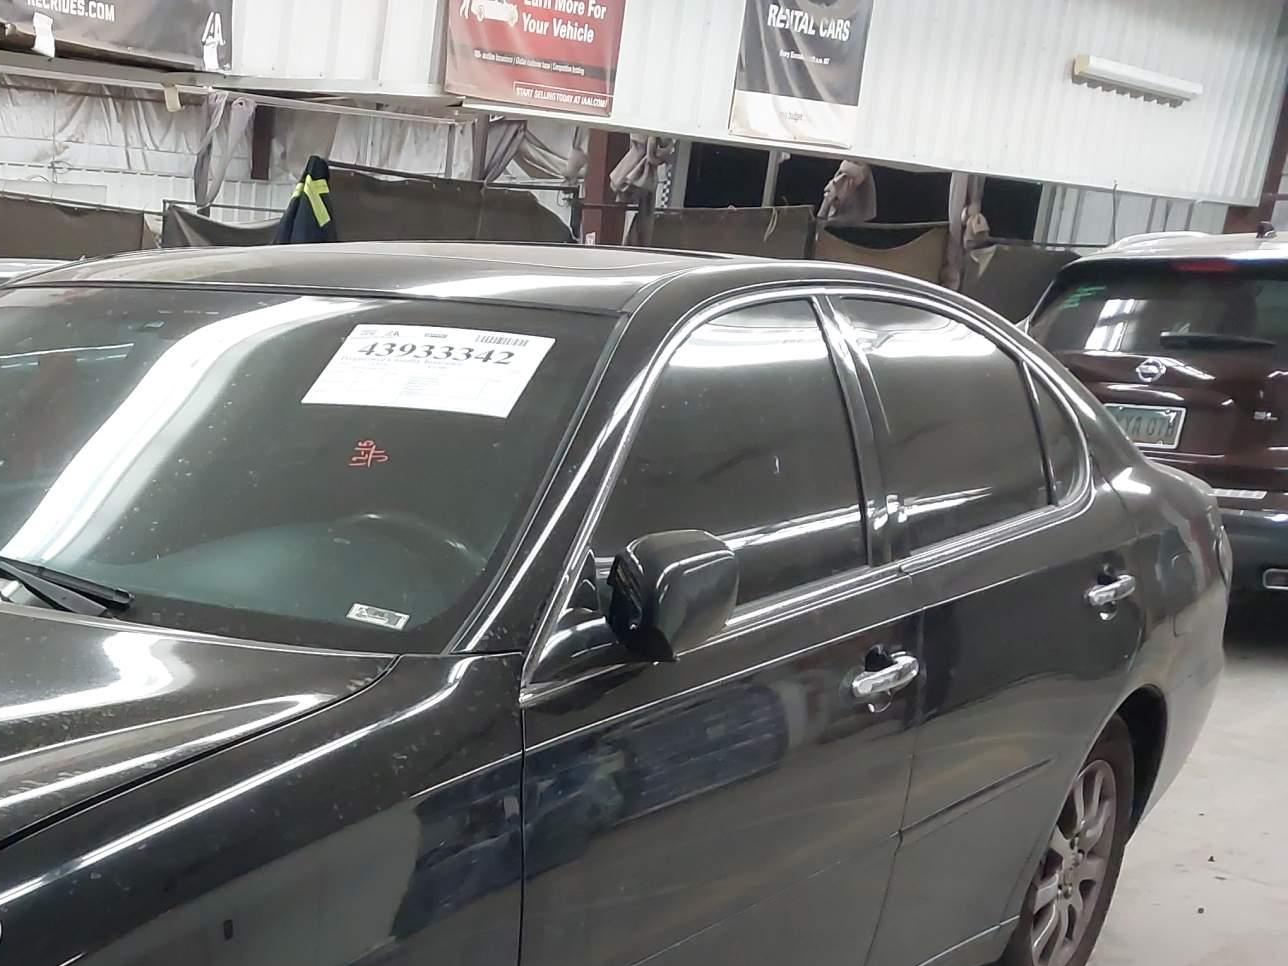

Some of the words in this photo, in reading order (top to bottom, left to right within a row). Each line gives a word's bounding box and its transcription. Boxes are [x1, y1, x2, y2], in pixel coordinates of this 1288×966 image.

[523, 0, 552, 10] arn
[554, 0, 585, 15] More
[587, 0, 607, 19] For
[767, 4, 816, 35] RENTAL
[819, 17, 851, 42] CARS
[522, 12, 550, 35] Your
[552, 17, 595, 43] Vehicle
[358, 341, 515, 366] 43933342
